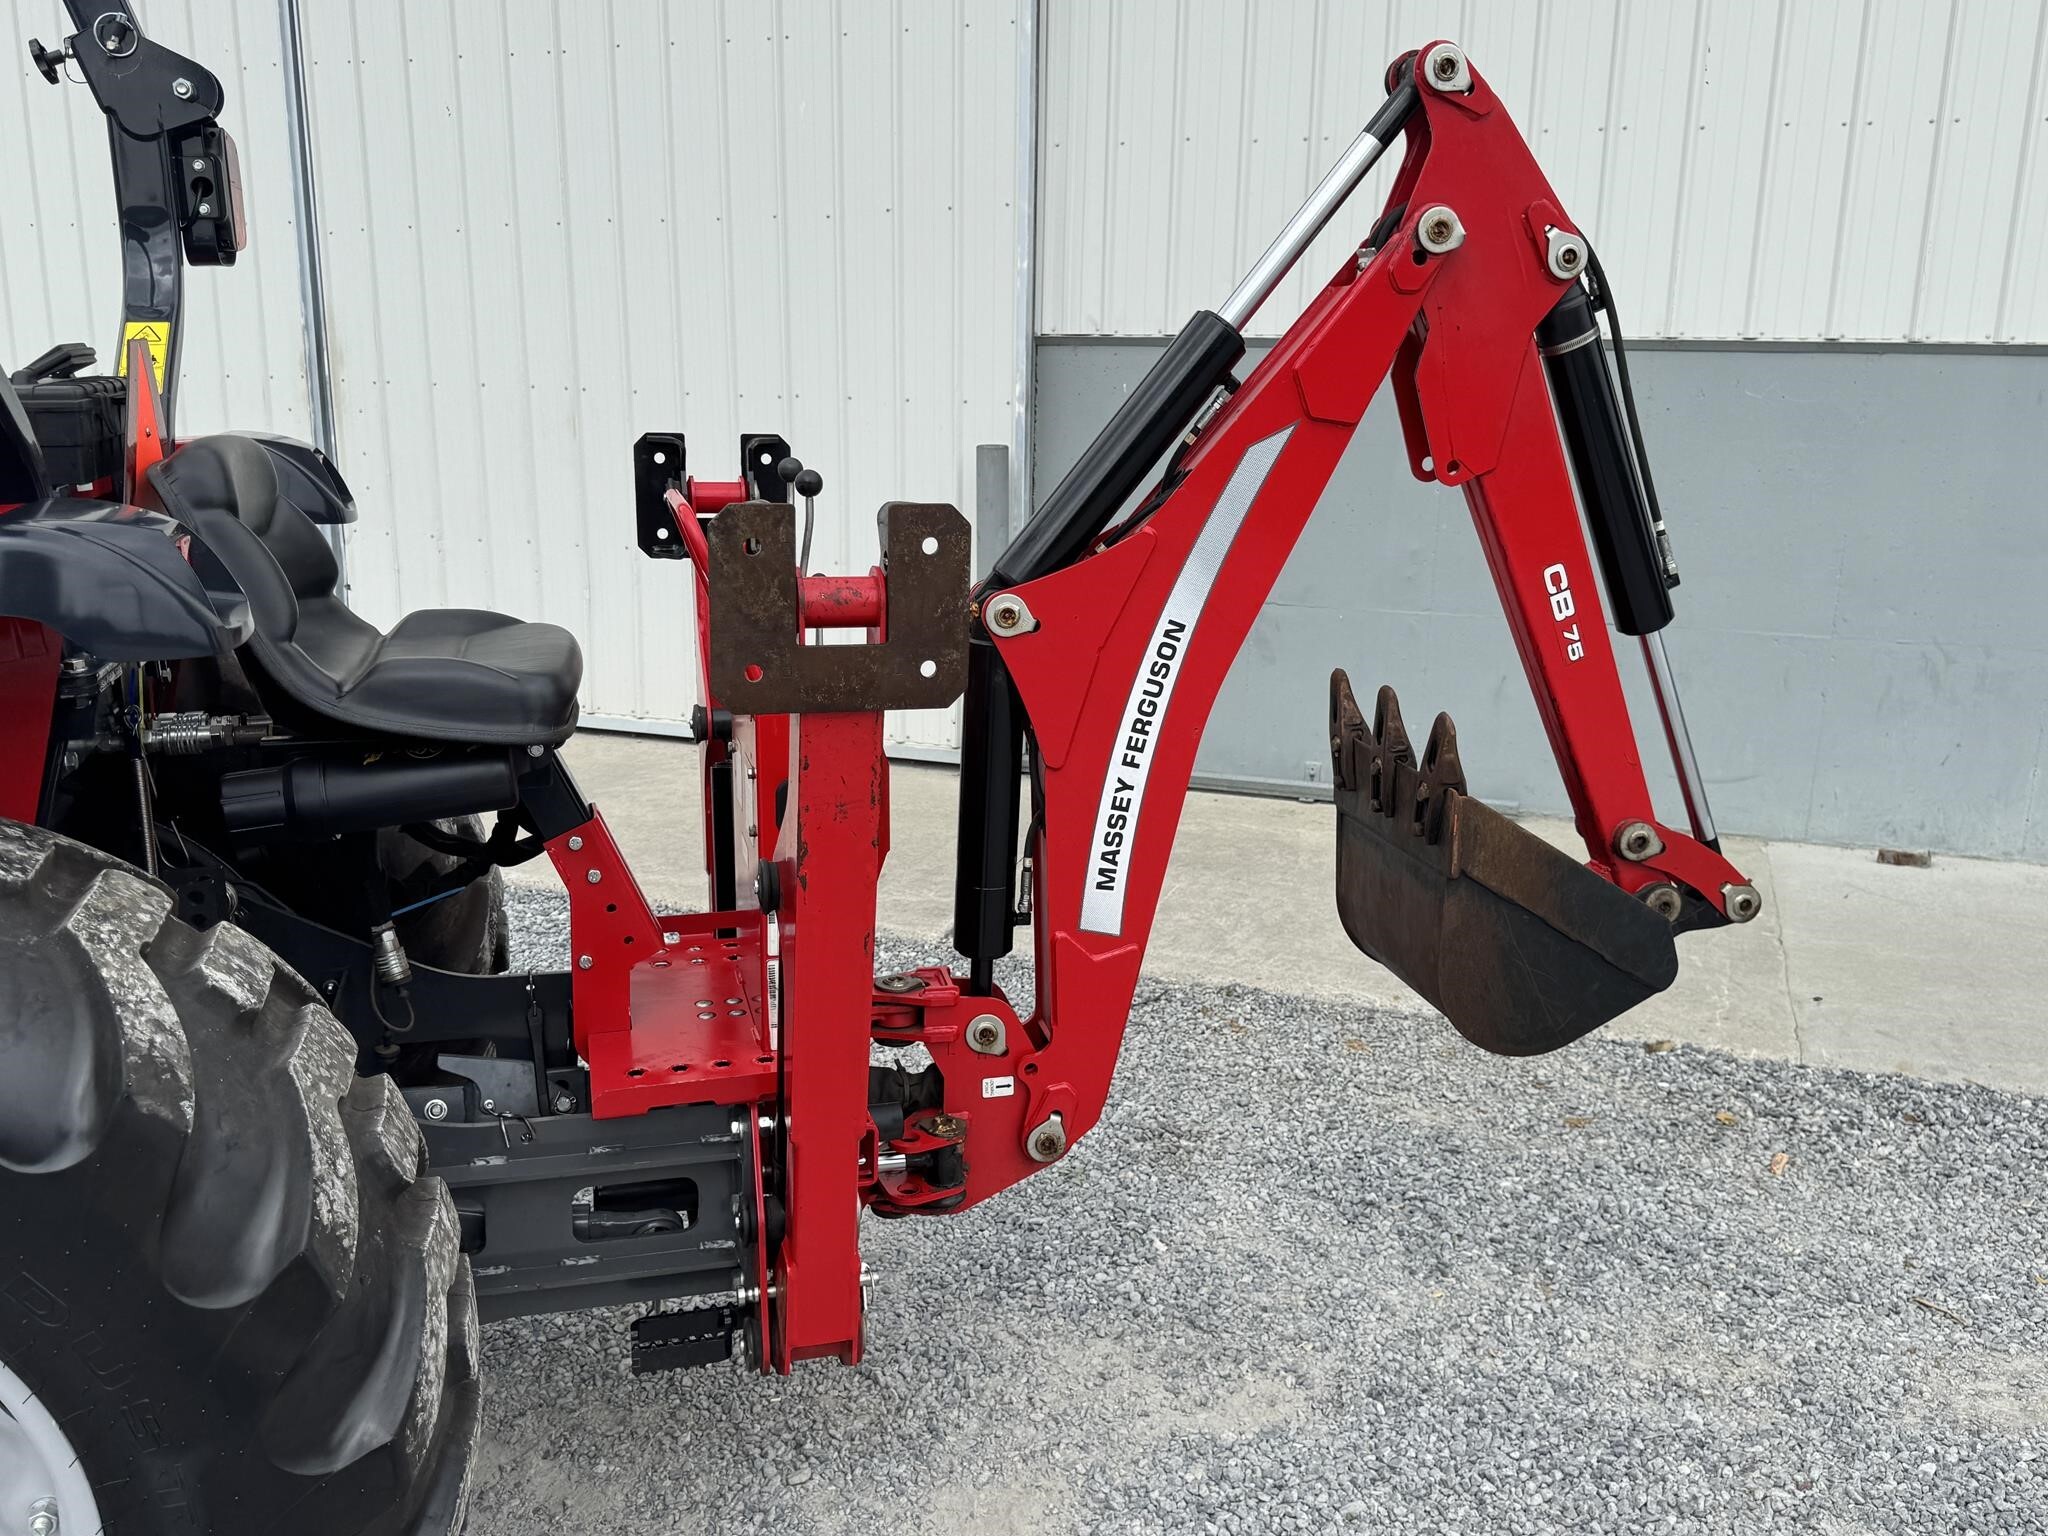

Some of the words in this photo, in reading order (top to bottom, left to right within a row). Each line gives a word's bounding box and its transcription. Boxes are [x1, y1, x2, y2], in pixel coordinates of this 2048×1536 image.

[1543, 562, 1576, 622] CB
[1562, 623, 1584, 661] 75
[1095, 777, 1135, 891] MASSEY
[1121, 619, 1187, 769] FERGUSON
